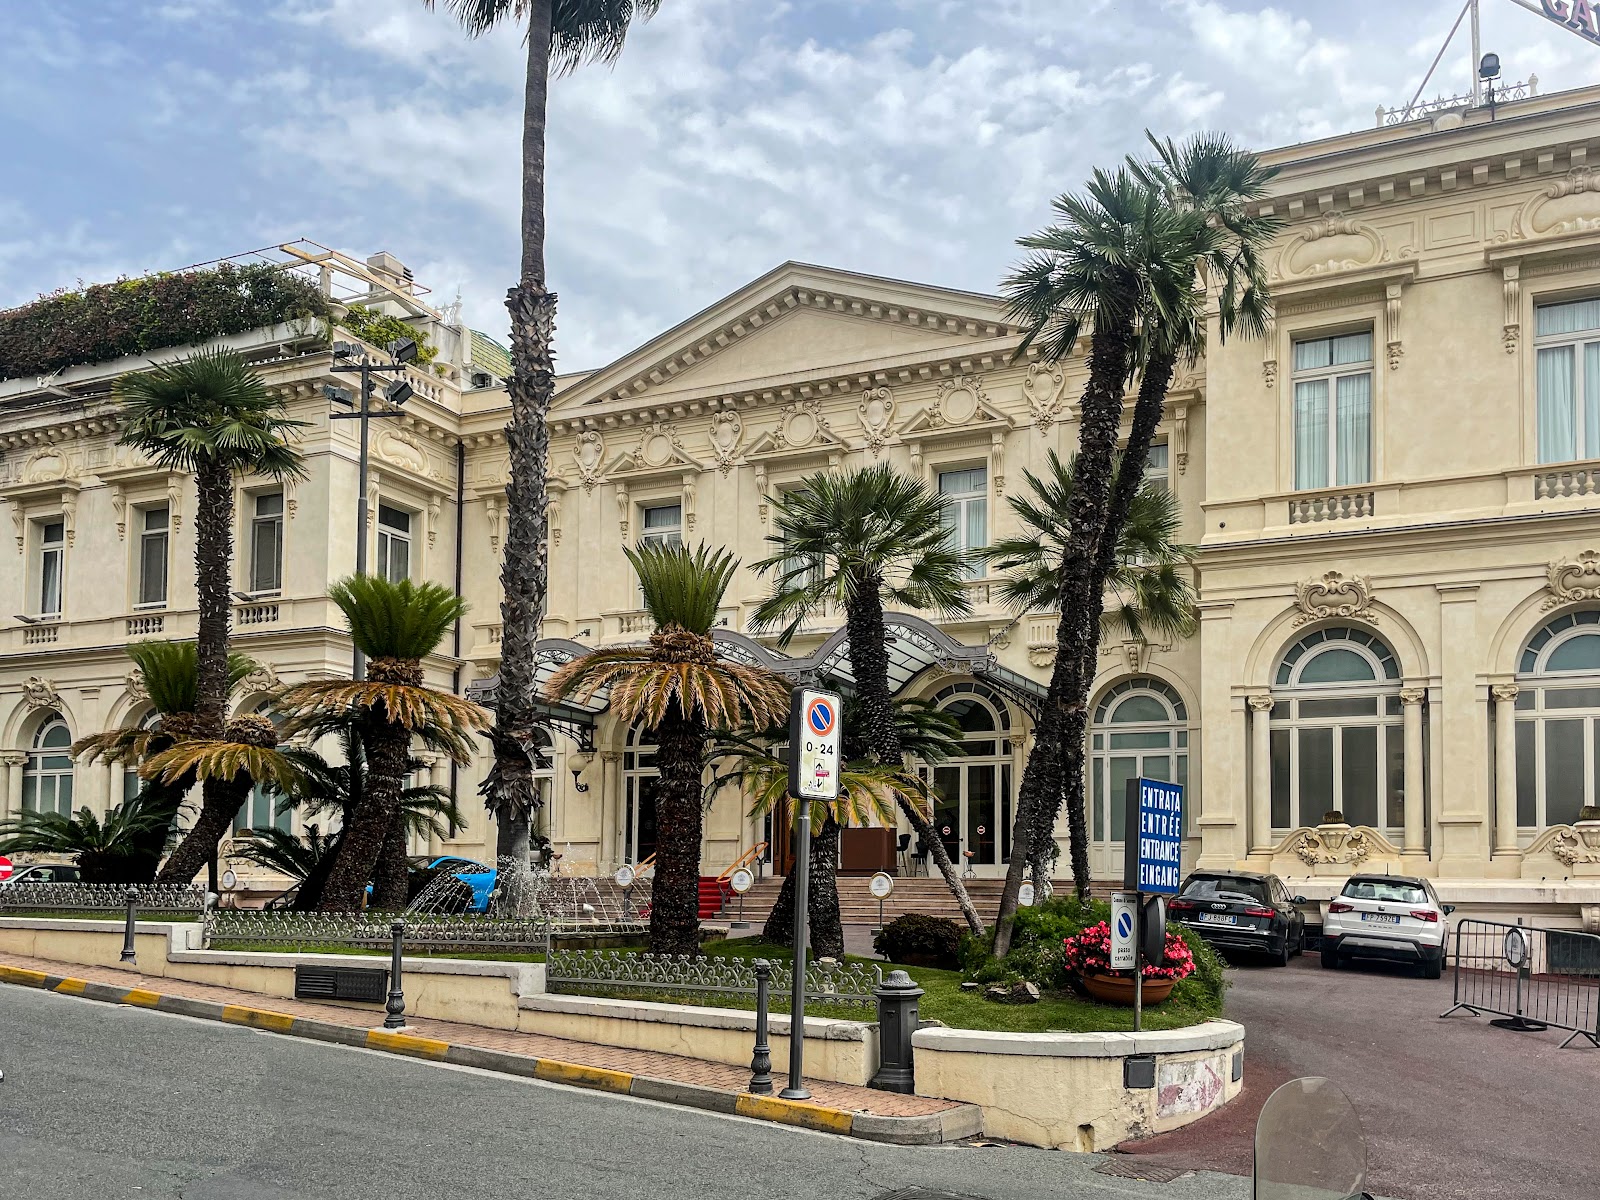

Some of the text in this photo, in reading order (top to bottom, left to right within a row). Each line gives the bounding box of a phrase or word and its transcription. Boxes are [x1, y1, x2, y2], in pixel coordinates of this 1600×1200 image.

[1540, 0, 1600, 42] GA
[1142, 786, 1180, 812] ENTRATA
[1141, 812, 1180, 837] ENTRÉE
[1140, 838, 1179, 862] ENTRANCE
[1140, 863, 1178, 887] EINGANG
[1114, 954, 1133, 962] carrabile
